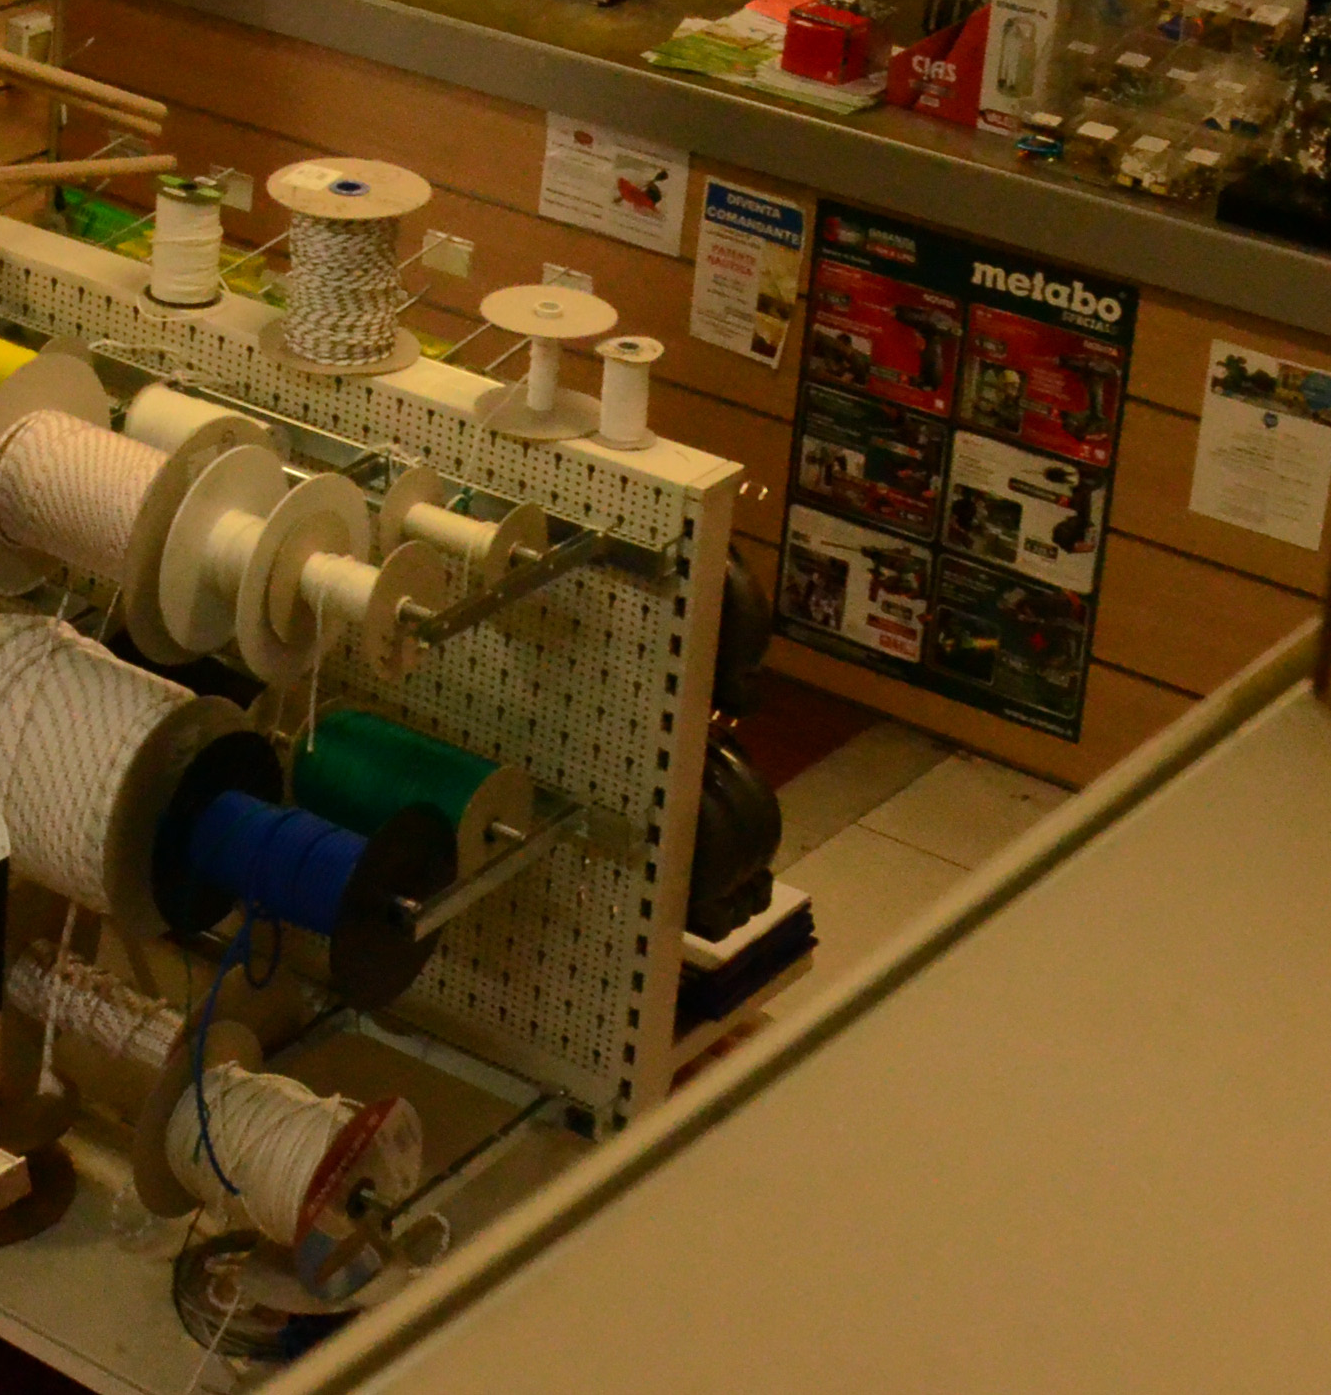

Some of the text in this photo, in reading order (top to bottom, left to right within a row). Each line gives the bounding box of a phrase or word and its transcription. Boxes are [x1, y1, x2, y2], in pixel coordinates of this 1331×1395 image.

[707, 205, 801, 245] COMANDANTE
[726, 192, 781, 219] DIVENTA
[971, 261, 1122, 322] metabo
